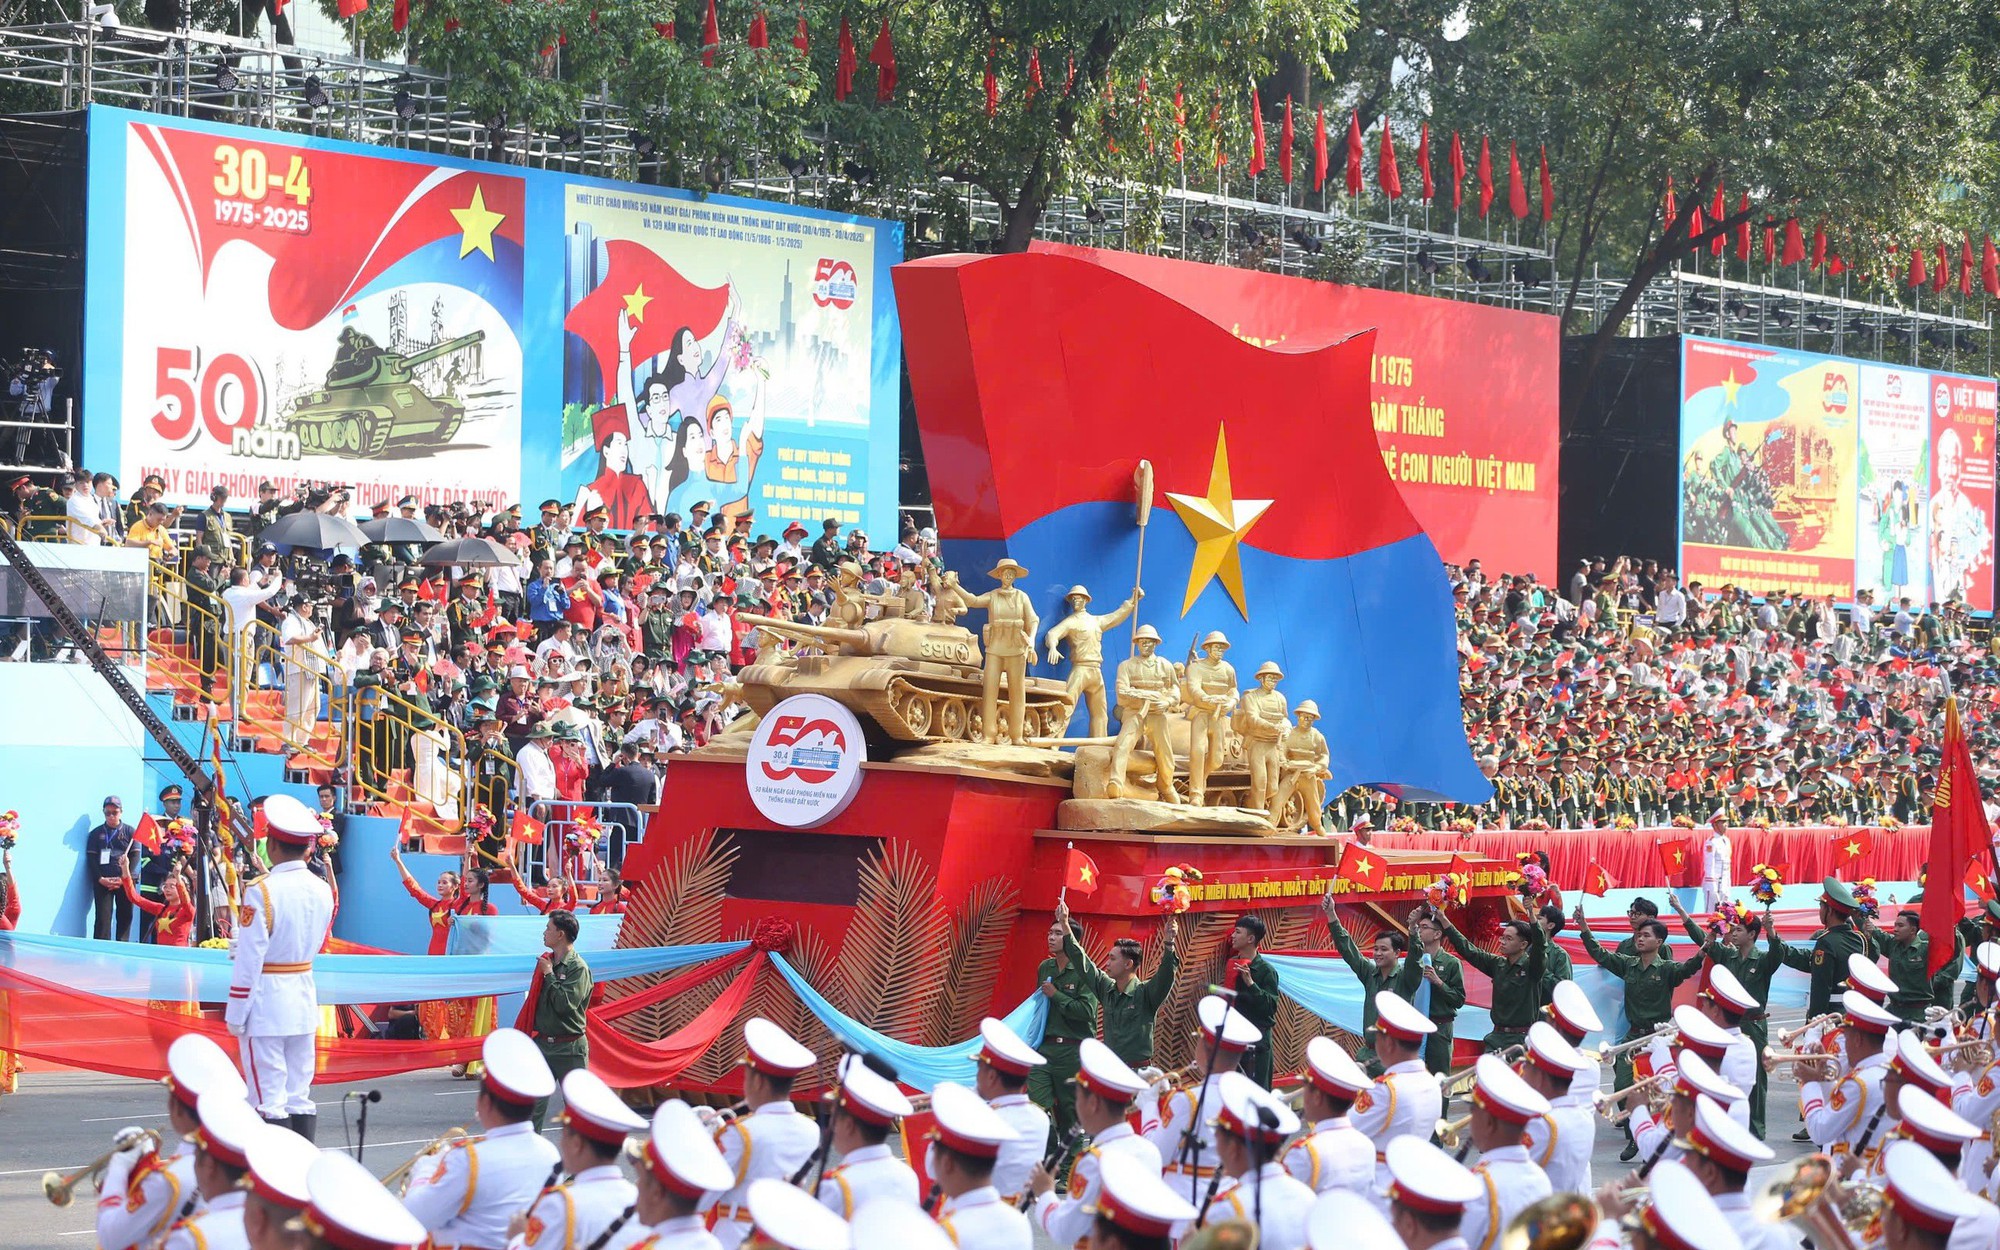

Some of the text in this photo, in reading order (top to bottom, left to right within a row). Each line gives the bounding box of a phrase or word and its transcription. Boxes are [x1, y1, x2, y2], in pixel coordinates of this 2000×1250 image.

[214, 144, 311, 206] 30-4
[1381, 355, 1412, 387] 1975
[151, 347, 258, 445] 50
[1953, 383, 1974, 410] VIỆT
[1371, 396, 1444, 437] OÀN THẮNG
[232, 424, 300, 460] năm
[141, 463, 181, 493] NÀY
[186, 463, 216, 497] GIẢI
[1400, 452, 1428, 483] CON
[1432, 450, 1472, 487] NGƯỜI
[1476, 454, 1502, 495] VIỆT
[1506, 461, 1535, 491] NAM
[921, 640, 954, 659] 390
[1205, 879, 1227, 900] MIỀN
[1252, 876, 1282, 898] THỐNG
[1283, 875, 1307, 896] NHẤT
[1308, 875, 1326, 895] ĐẤT
[1394, 872, 1413, 893] MỘT
